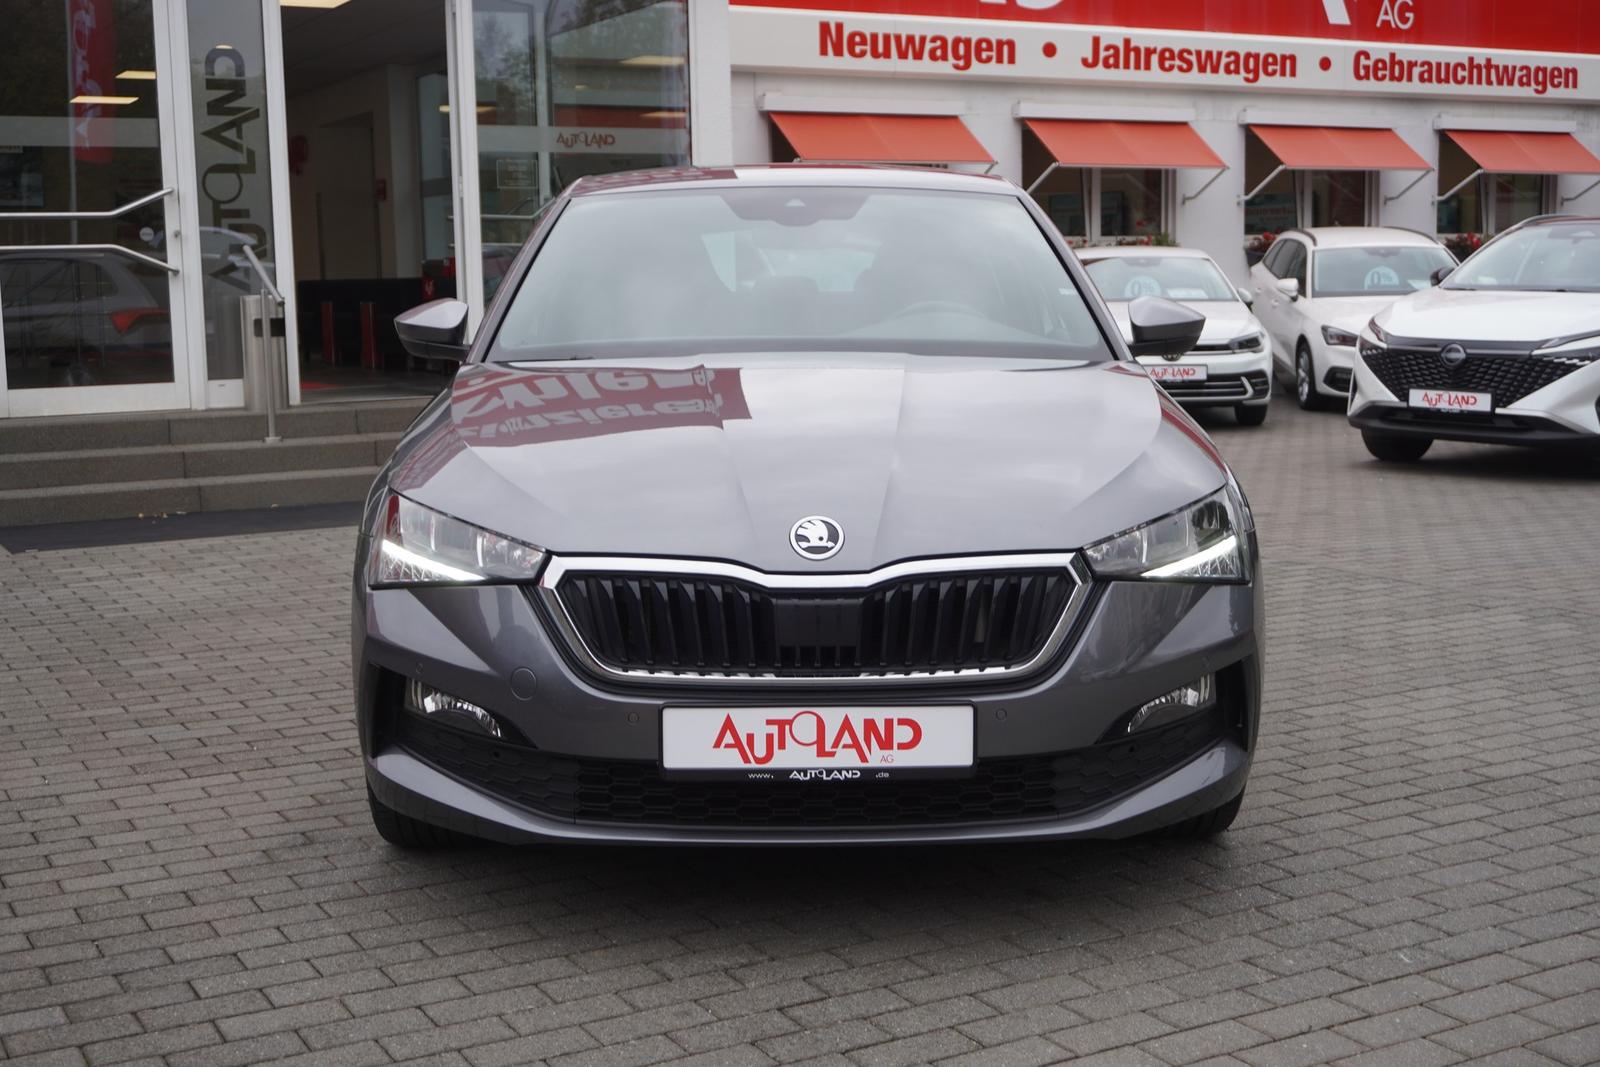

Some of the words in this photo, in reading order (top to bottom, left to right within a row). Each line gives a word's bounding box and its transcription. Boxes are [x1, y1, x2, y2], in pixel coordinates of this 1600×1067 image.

[1376, 0, 1415, 29] AG
[819, 21, 1017, 71] Neuwagen
[1081, 35, 1297, 83] Jahreswagen
[1353, 50, 1579, 95] Gebrauchtwagen
[556, 131, 616, 148] AUTOLAND
[713, 711, 922, 764] AUTOLAND
[879, 754, 894, 764] AG
[788, 768, 861, 781] AUTOLAND
